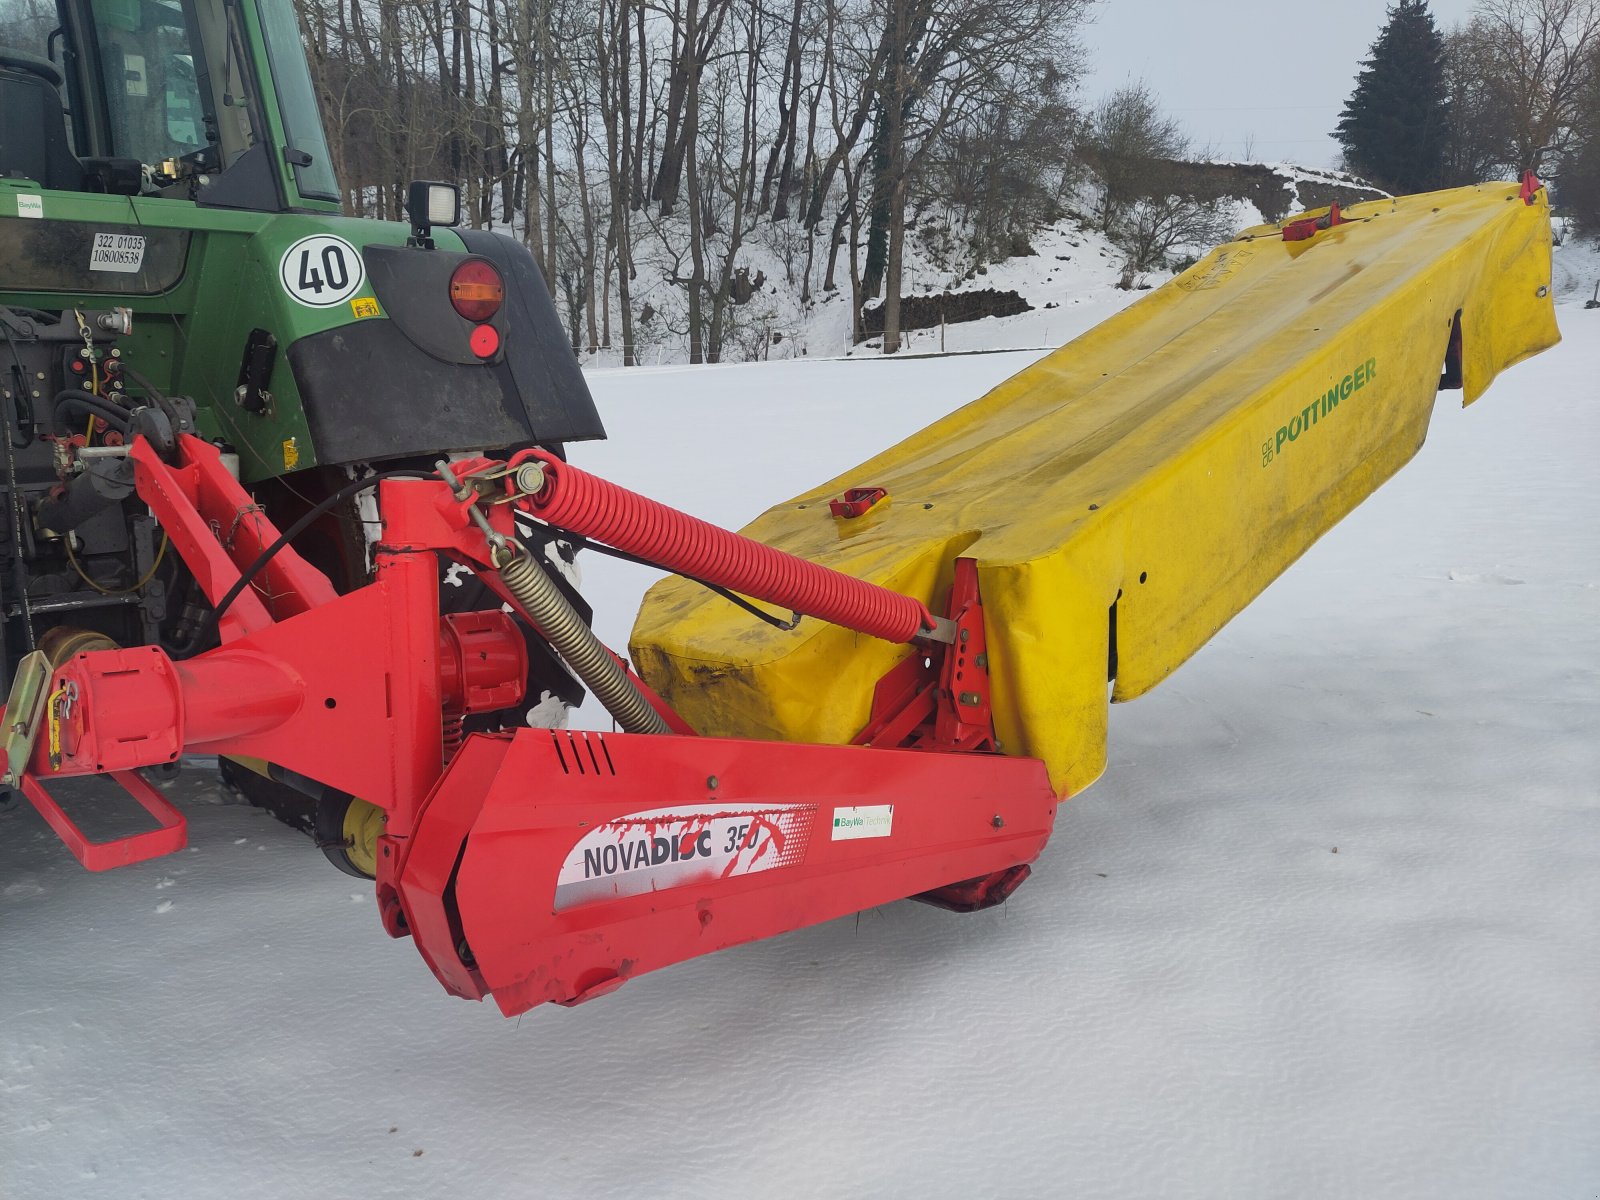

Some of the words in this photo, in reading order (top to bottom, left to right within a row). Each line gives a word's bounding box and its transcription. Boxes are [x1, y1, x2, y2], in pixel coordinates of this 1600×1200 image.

[98, 235, 113, 248] 322
[117, 236, 143, 250] 01035
[93, 249, 140, 264] 108008538
[298, 244, 349, 294] 40
[1275, 356, 1377, 455] PÖTTINGER
[840, 817, 864, 829] BayWa
